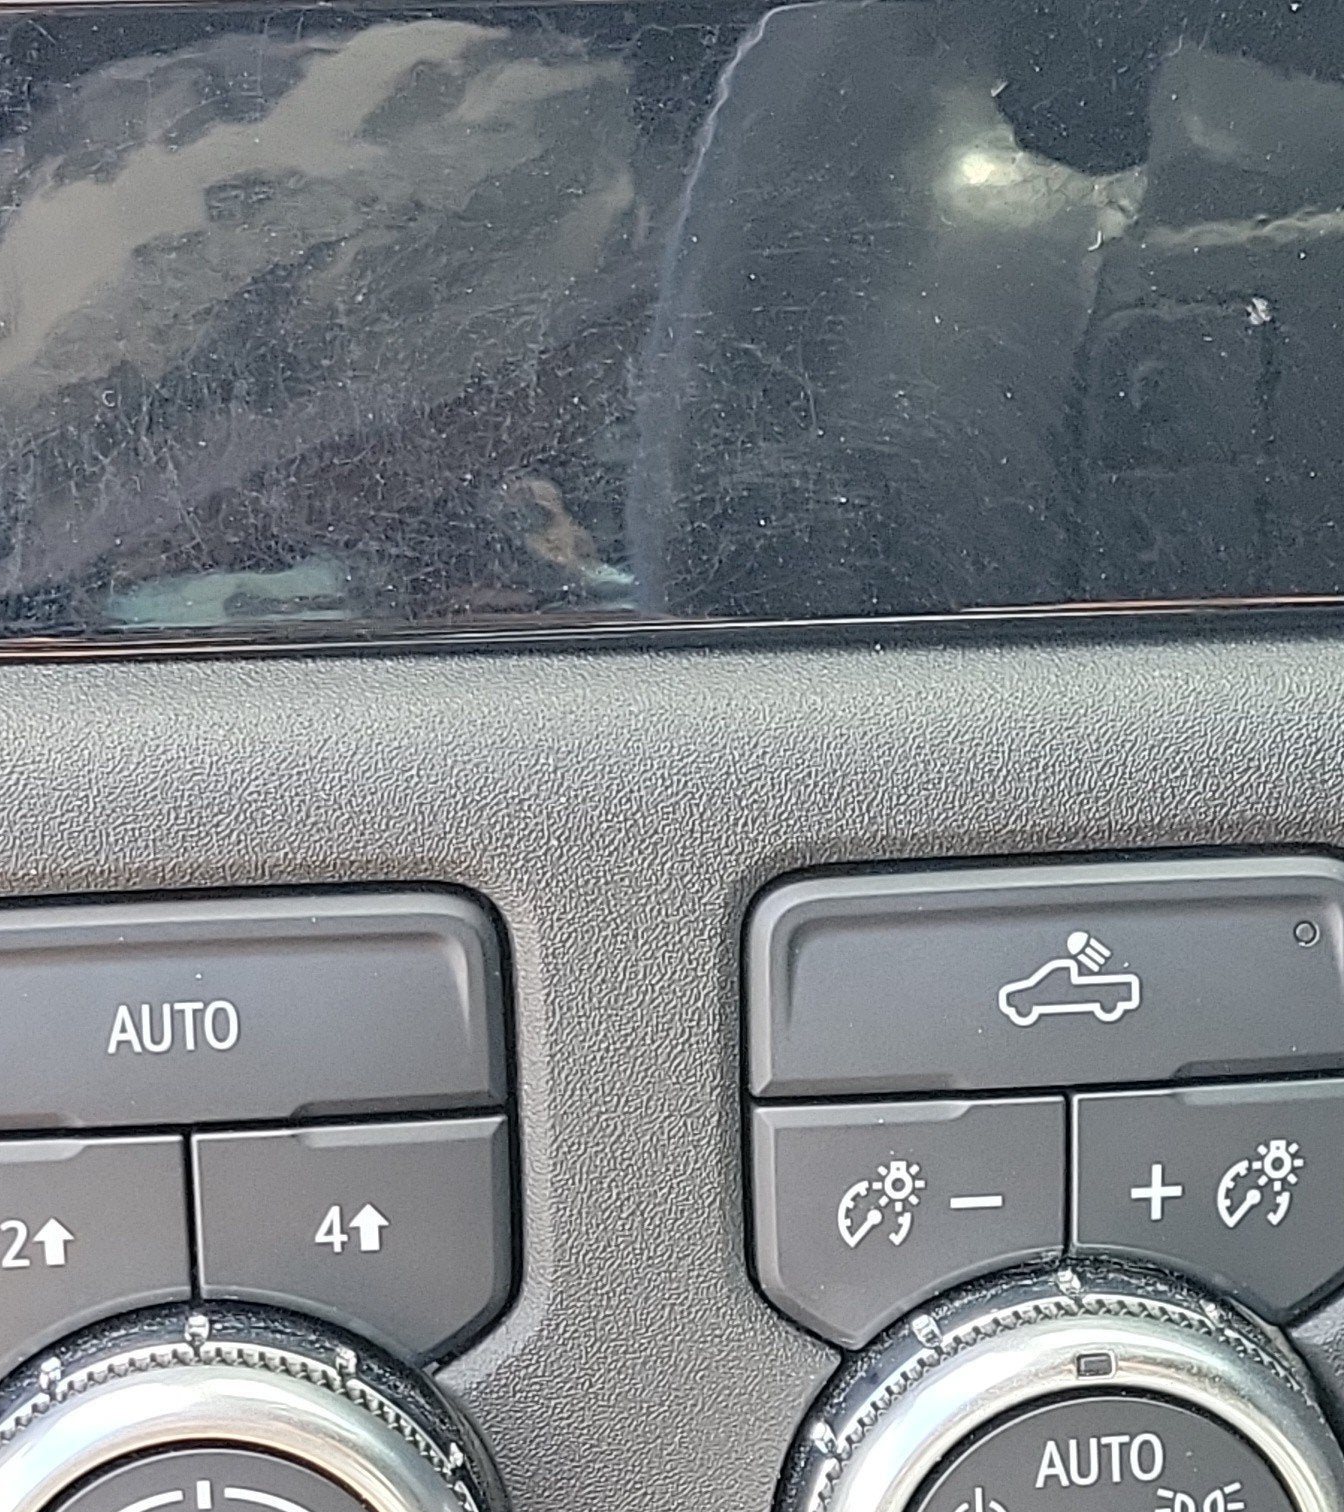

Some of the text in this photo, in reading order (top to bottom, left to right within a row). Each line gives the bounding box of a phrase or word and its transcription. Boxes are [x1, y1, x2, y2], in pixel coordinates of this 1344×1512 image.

[107, 999, 238, 1054] AUTO
[0, 1220, 31, 1269] 2
[314, 1205, 348, 1253] 4
[1035, 1432, 1164, 1488] AUTO
